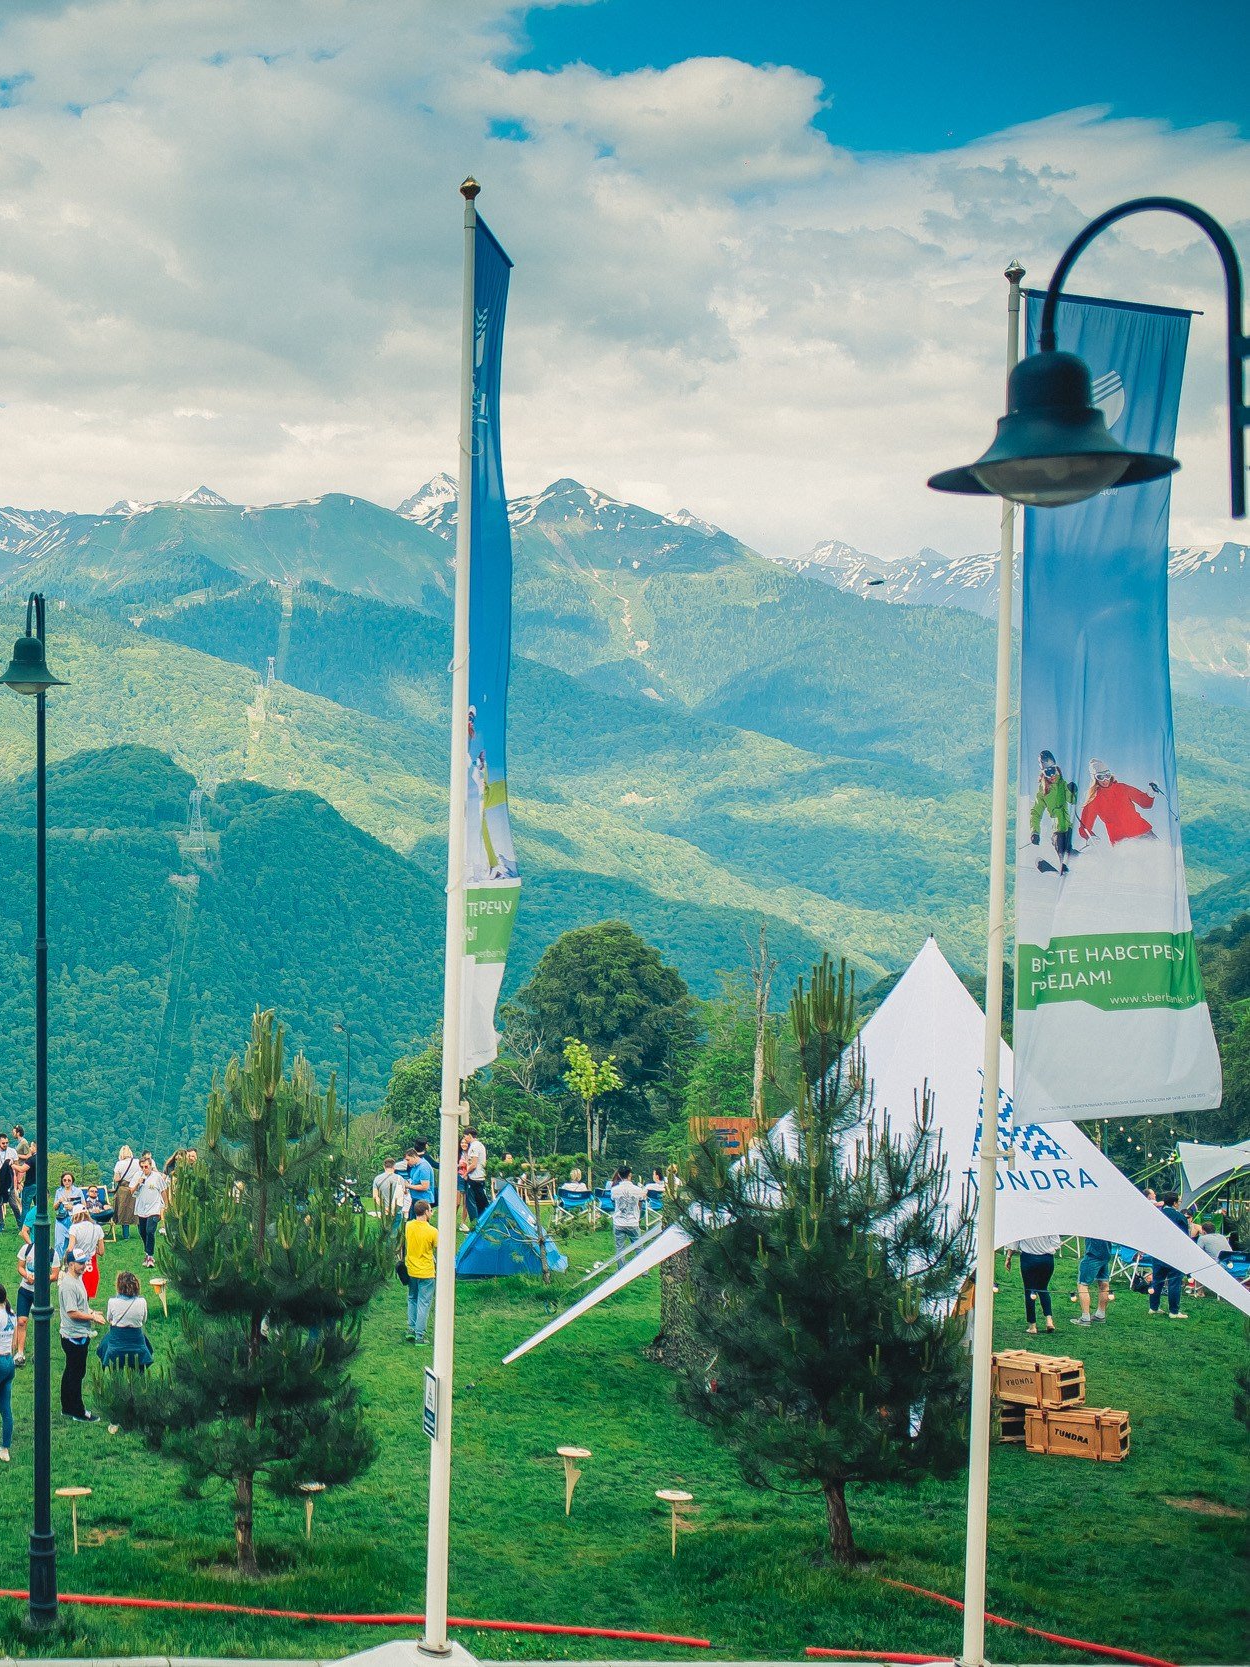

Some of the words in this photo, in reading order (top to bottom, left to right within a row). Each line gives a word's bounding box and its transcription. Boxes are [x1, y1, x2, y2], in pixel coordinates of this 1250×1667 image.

[1085, 944, 1185, 962] НАВСТРЕУ
[962, 1167, 1099, 1191] TUNDRA
[1005, 1377, 1034, 1386] TUNDRA
[1054, 1428, 1089, 1445] TUNDRA
